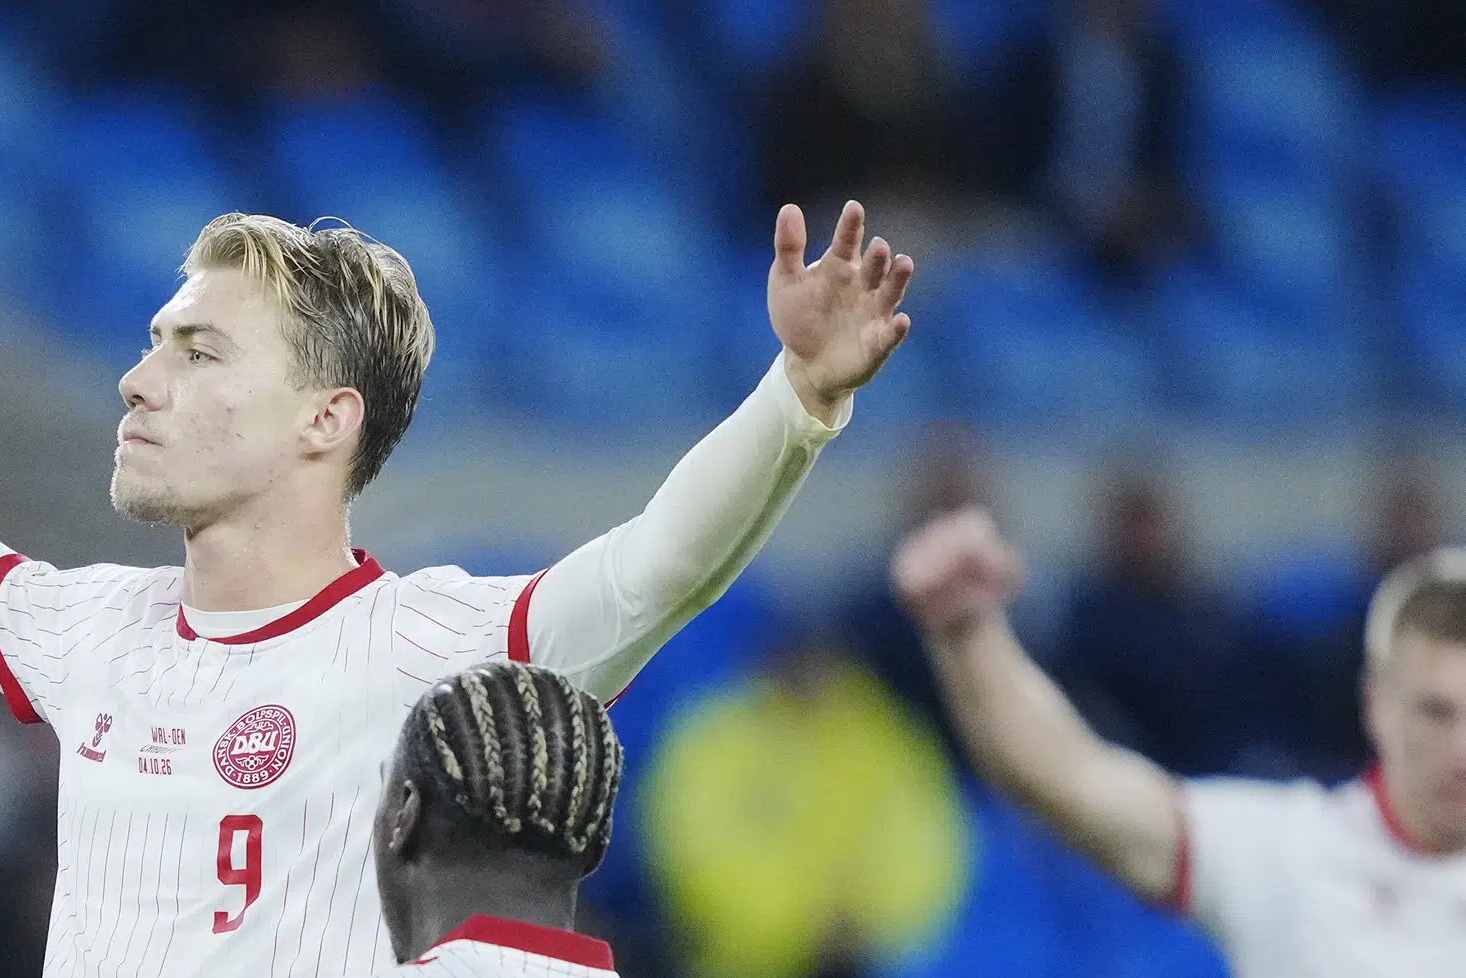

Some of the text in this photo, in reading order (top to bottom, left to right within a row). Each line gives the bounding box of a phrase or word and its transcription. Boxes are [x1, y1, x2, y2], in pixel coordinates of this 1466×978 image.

[151, 727, 186, 745] WAL-DEN
[230, 731, 278, 755] DBU
[271, 726, 291, 770] UNION
[218, 733, 235, 776] DANSK
[236, 770, 269, 783] 1889
[212, 814, 263, 934] 9
